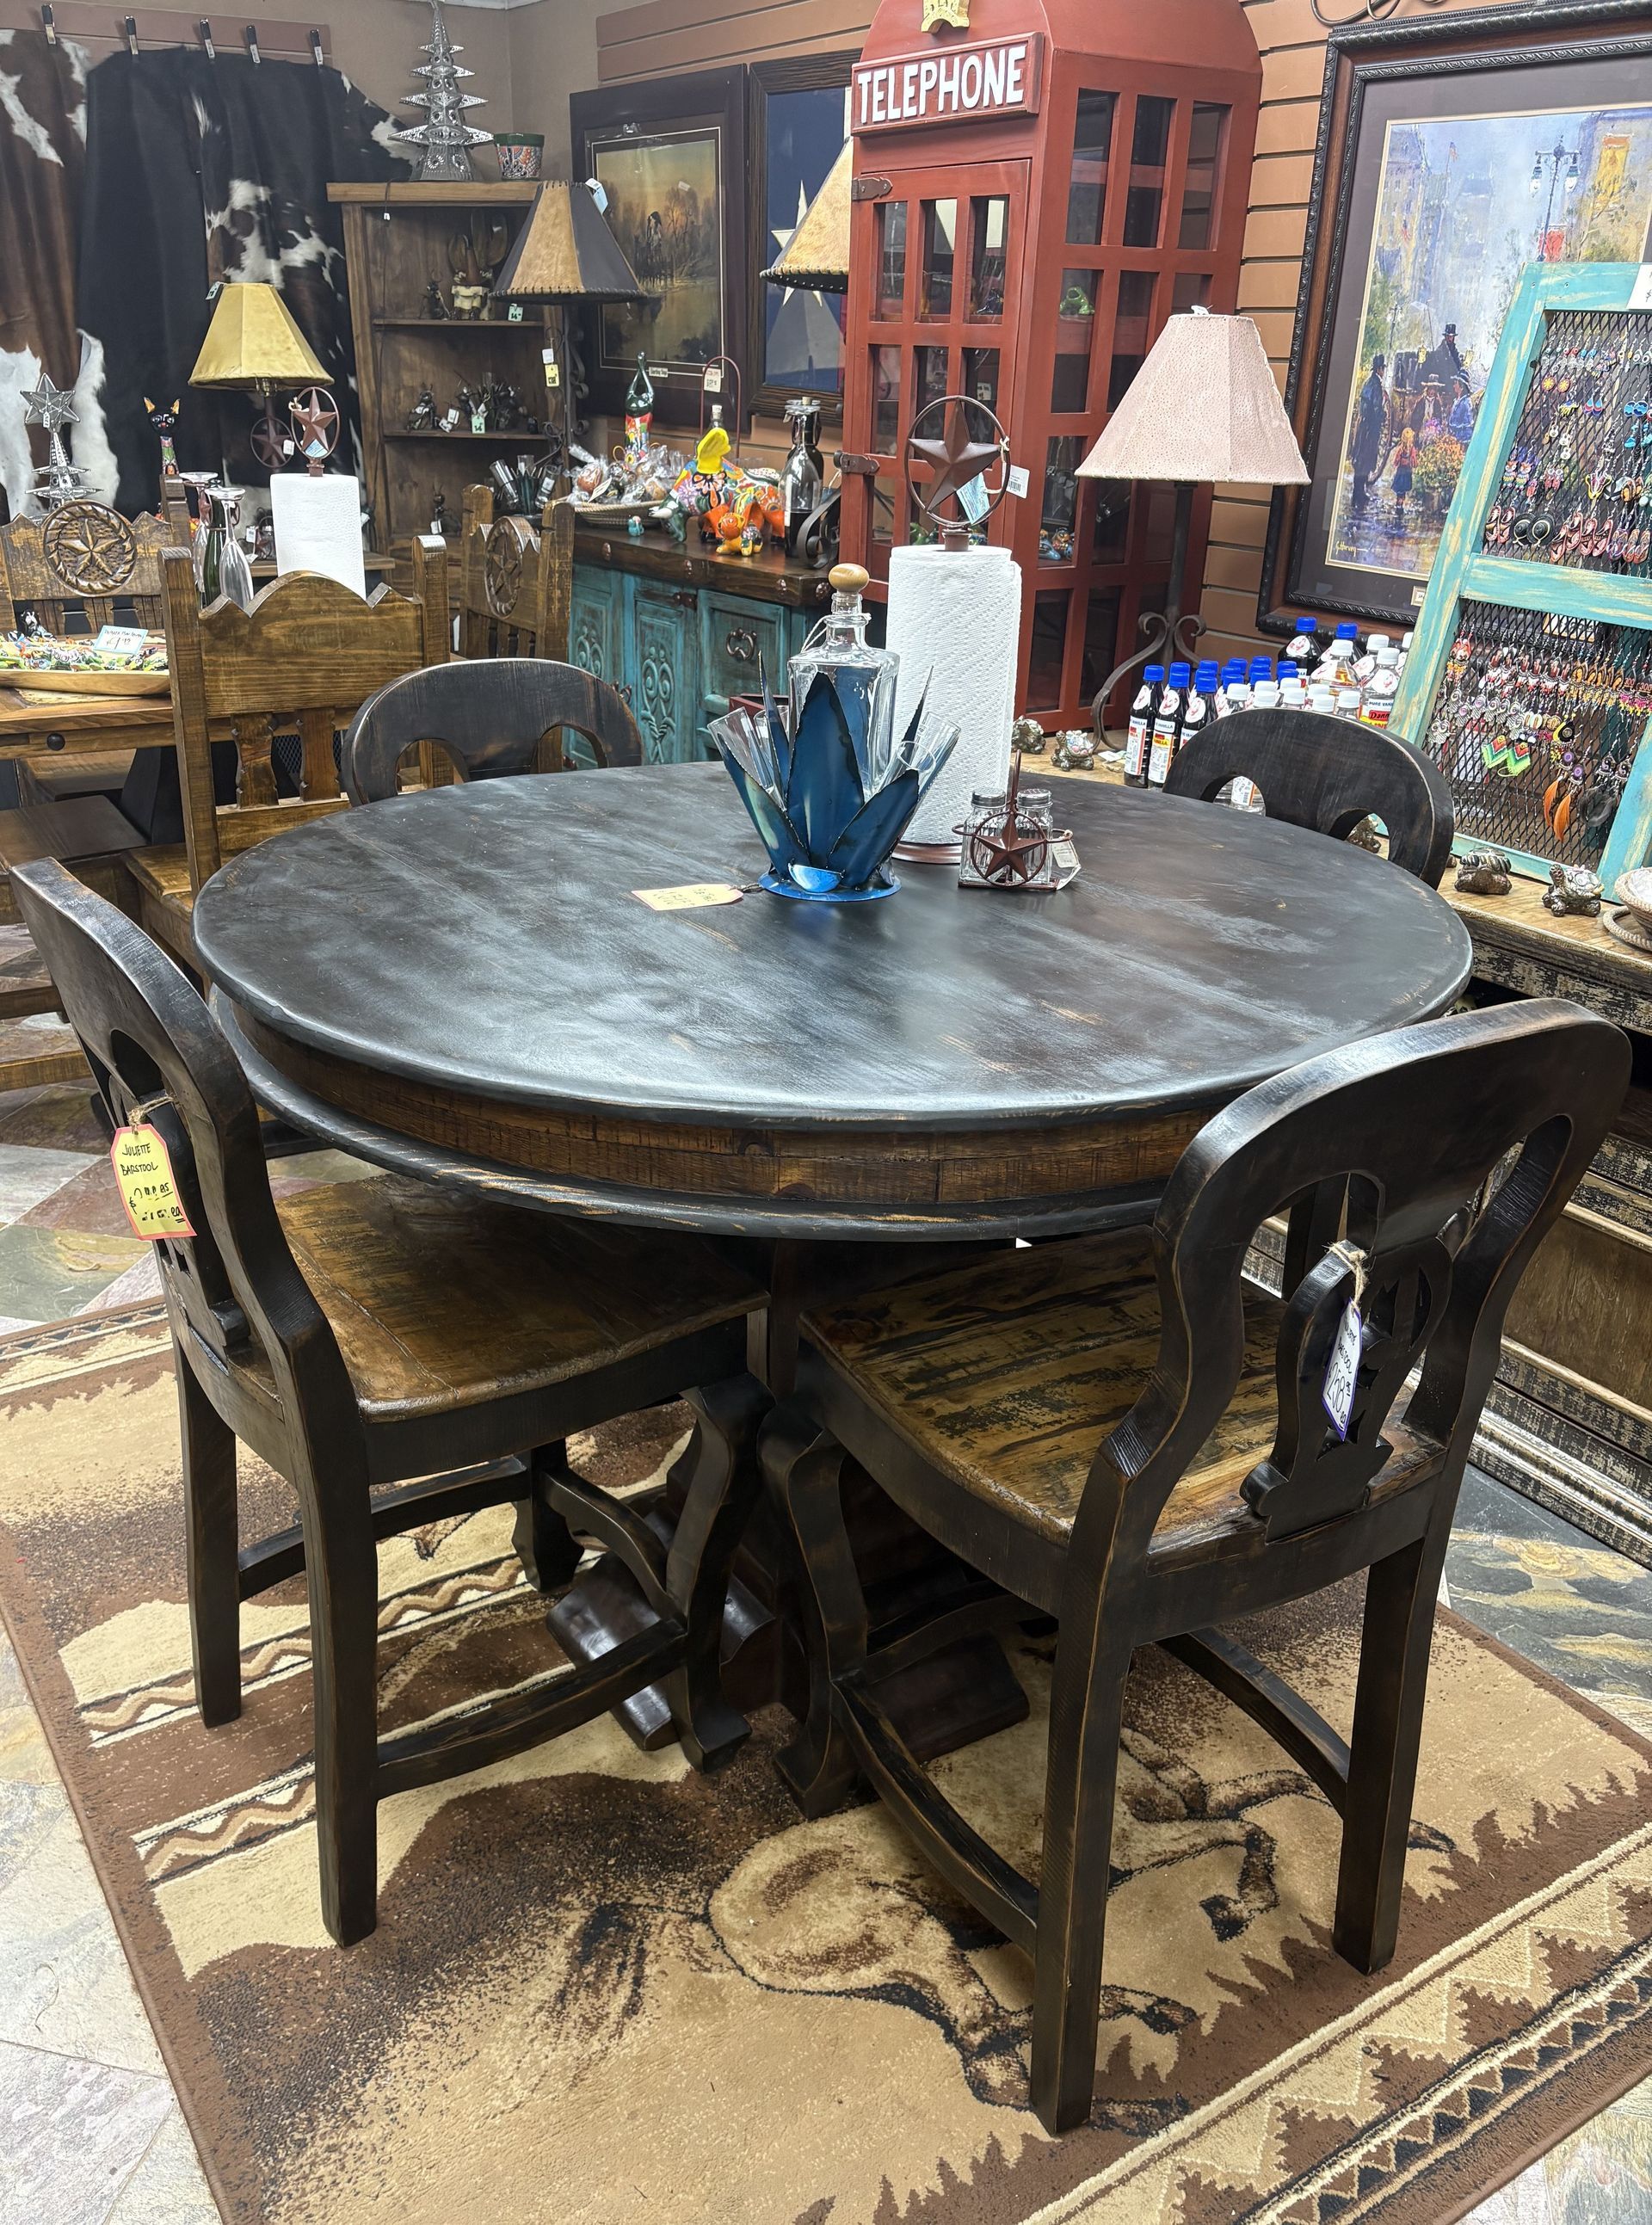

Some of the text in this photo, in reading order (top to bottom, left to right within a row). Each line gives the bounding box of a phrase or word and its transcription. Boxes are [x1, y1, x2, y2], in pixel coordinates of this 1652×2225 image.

[857, 45, 1026, 124] TELEPHONE
[121, 1143, 151, 1156] JULIETTE
[120, 1162, 159, 1176] BARSTOOL
